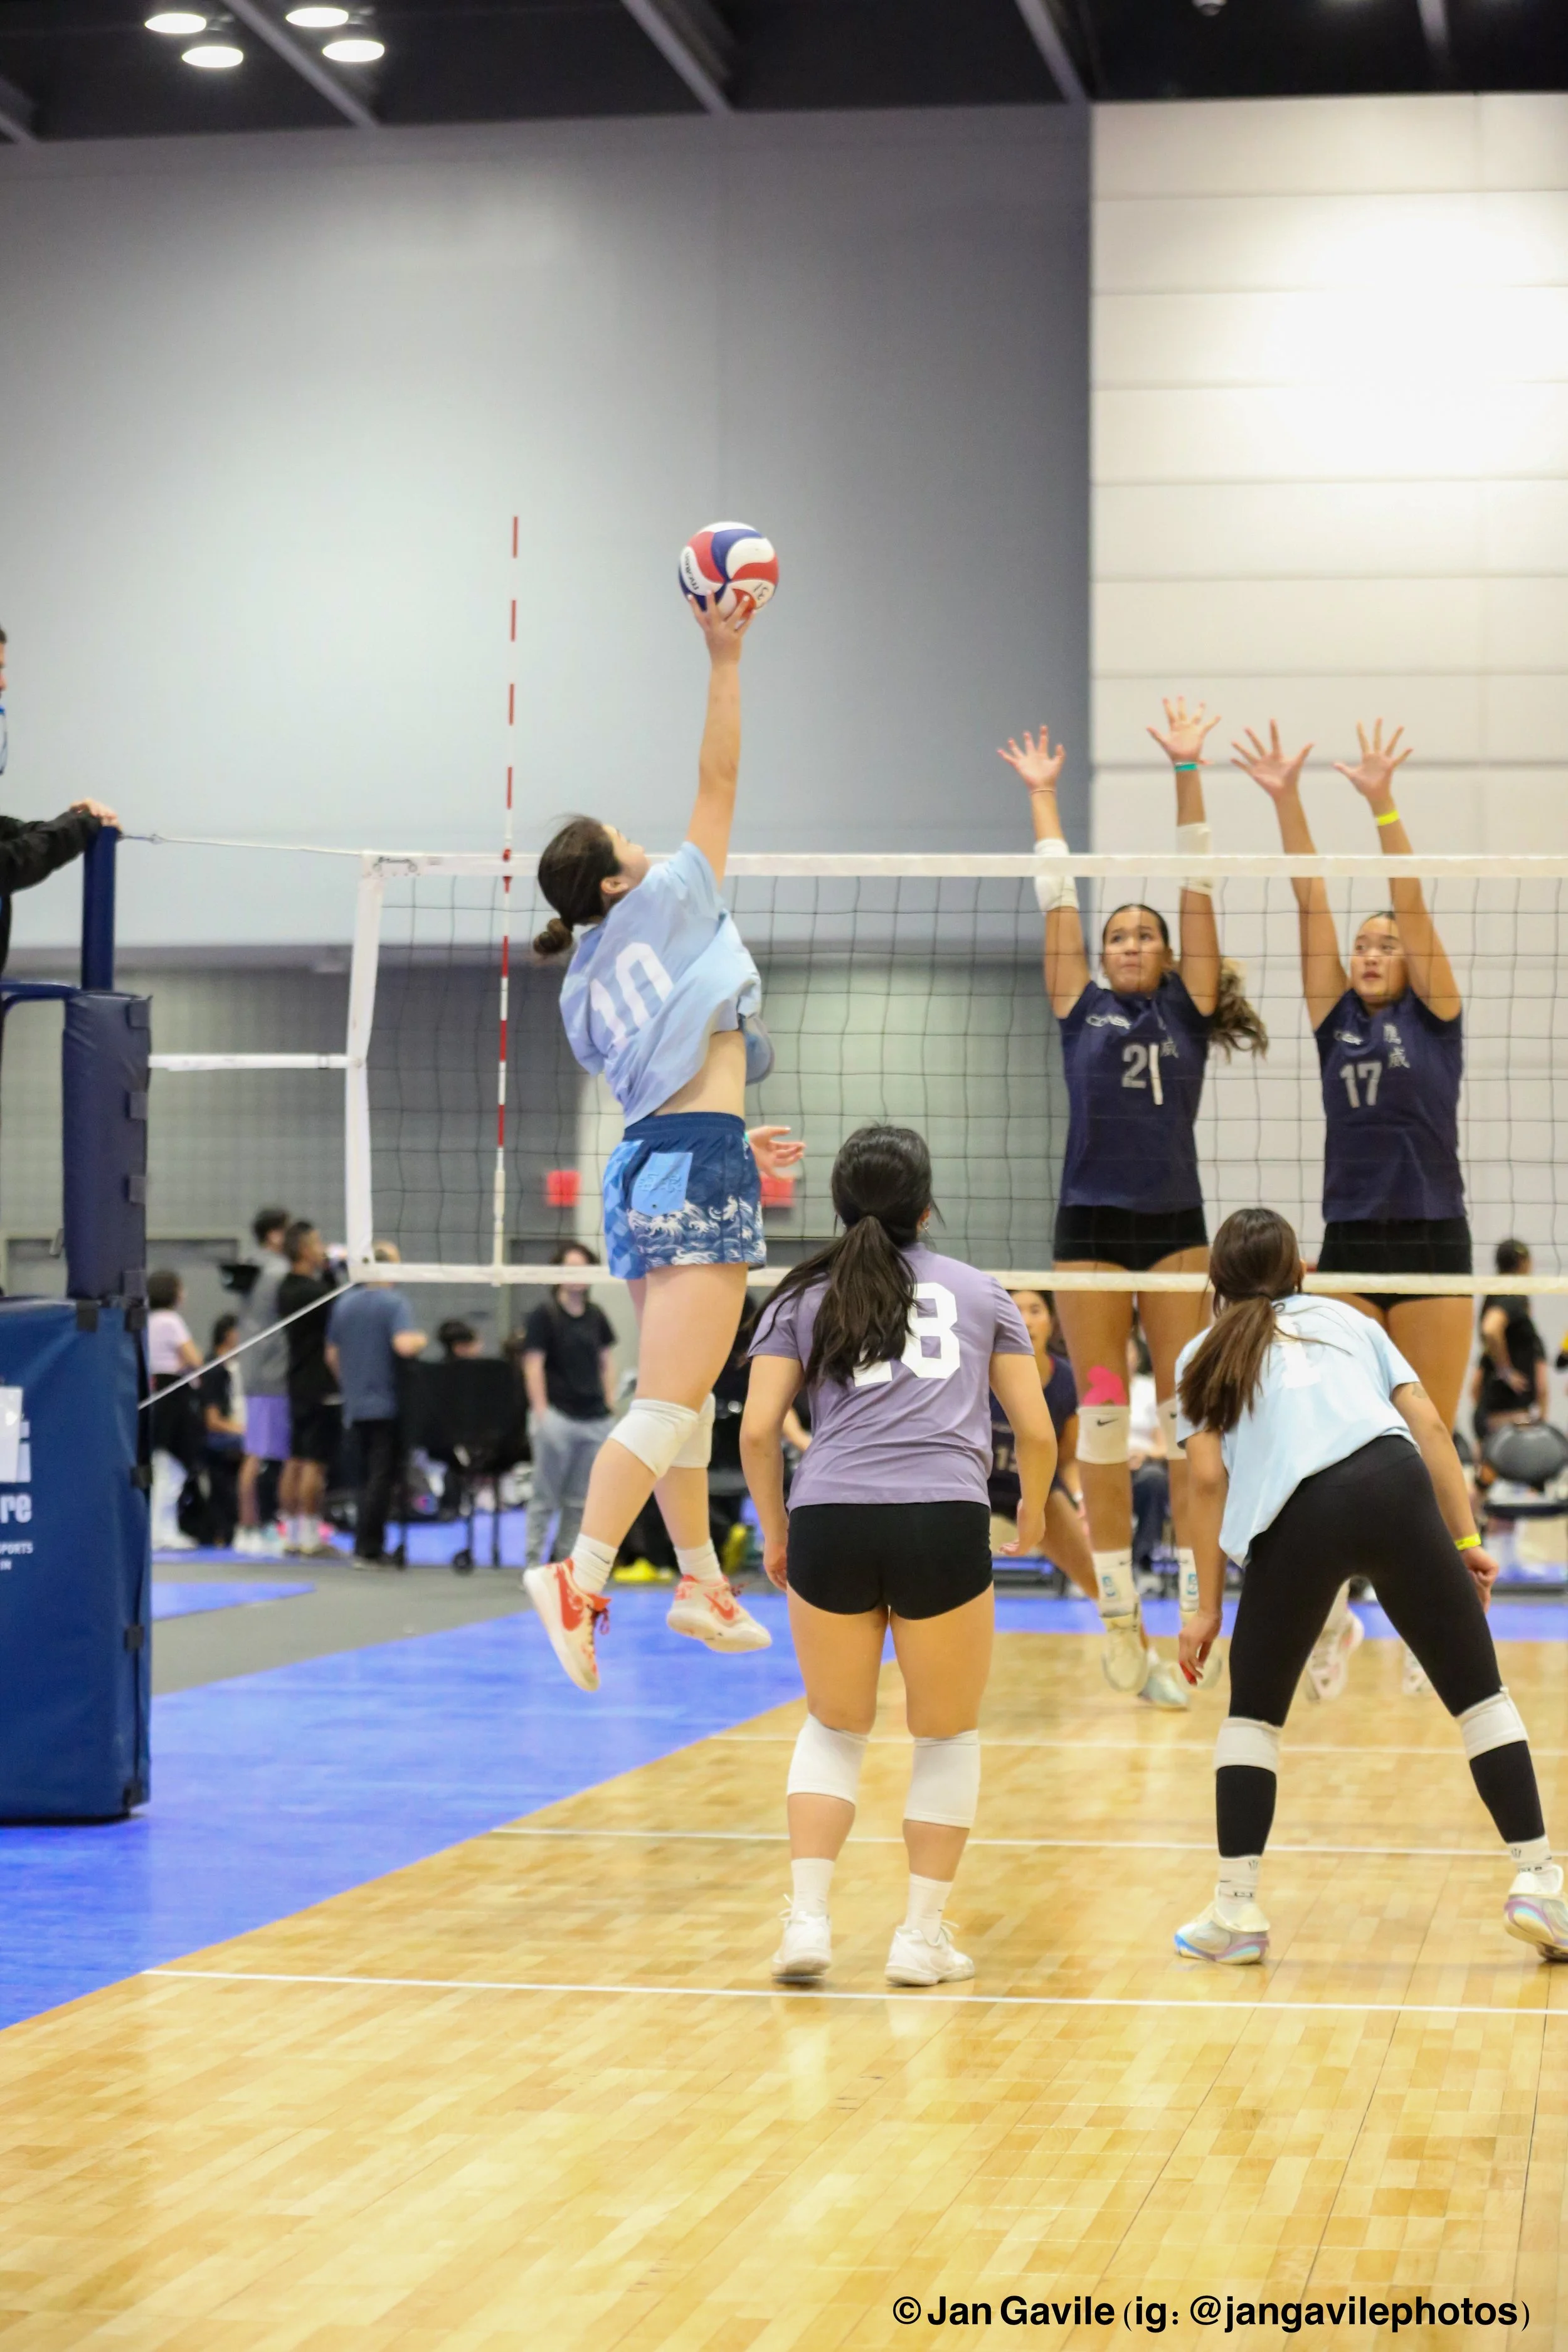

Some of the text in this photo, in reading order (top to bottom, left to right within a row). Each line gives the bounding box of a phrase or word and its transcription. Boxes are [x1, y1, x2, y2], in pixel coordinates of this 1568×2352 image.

[590, 942, 674, 1052] 10
[1121, 1042, 1164, 1105] 21
[1340, 1061, 1383, 1108] 17
[853, 1282, 961, 1387] 8
